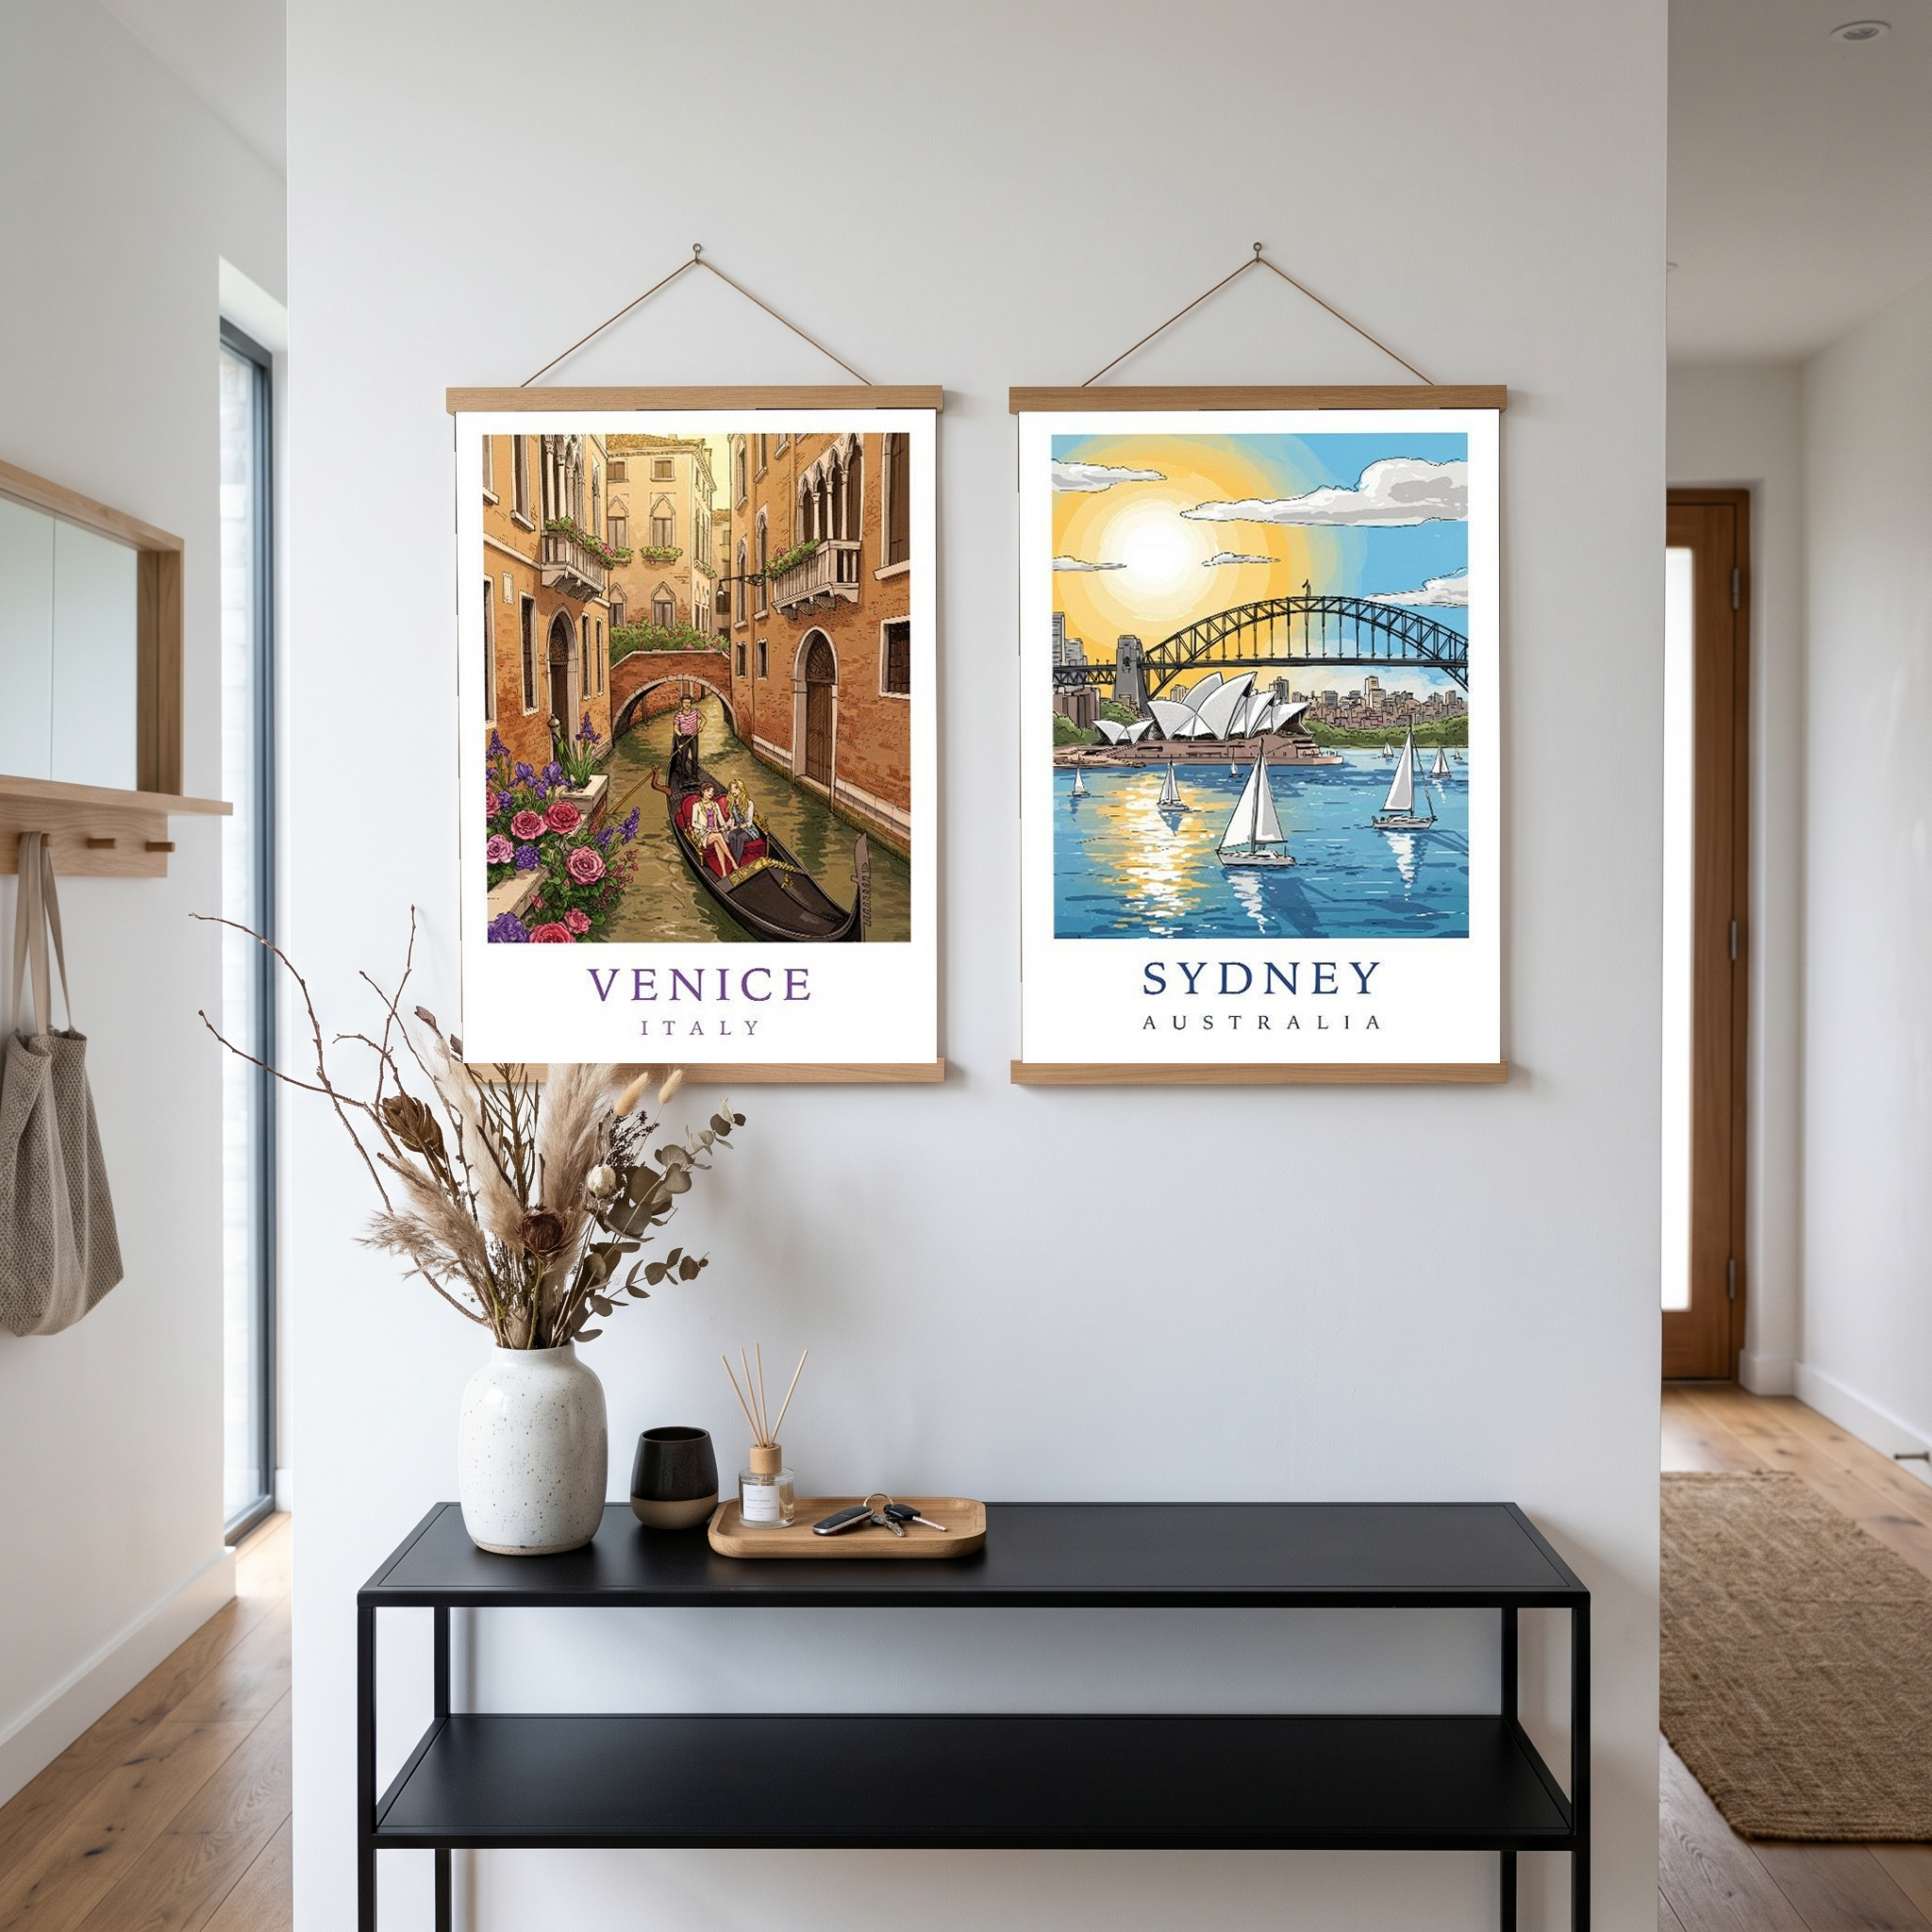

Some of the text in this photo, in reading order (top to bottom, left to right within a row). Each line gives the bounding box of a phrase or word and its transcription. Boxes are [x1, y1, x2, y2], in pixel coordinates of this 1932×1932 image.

[587, 968, 811, 1002] VENICE
[1143, 961, 1380, 996] SYDNEY
[641, 1021, 759, 1036] ITALY
[1142, 1015, 1380, 1031] AUSTRALIA
